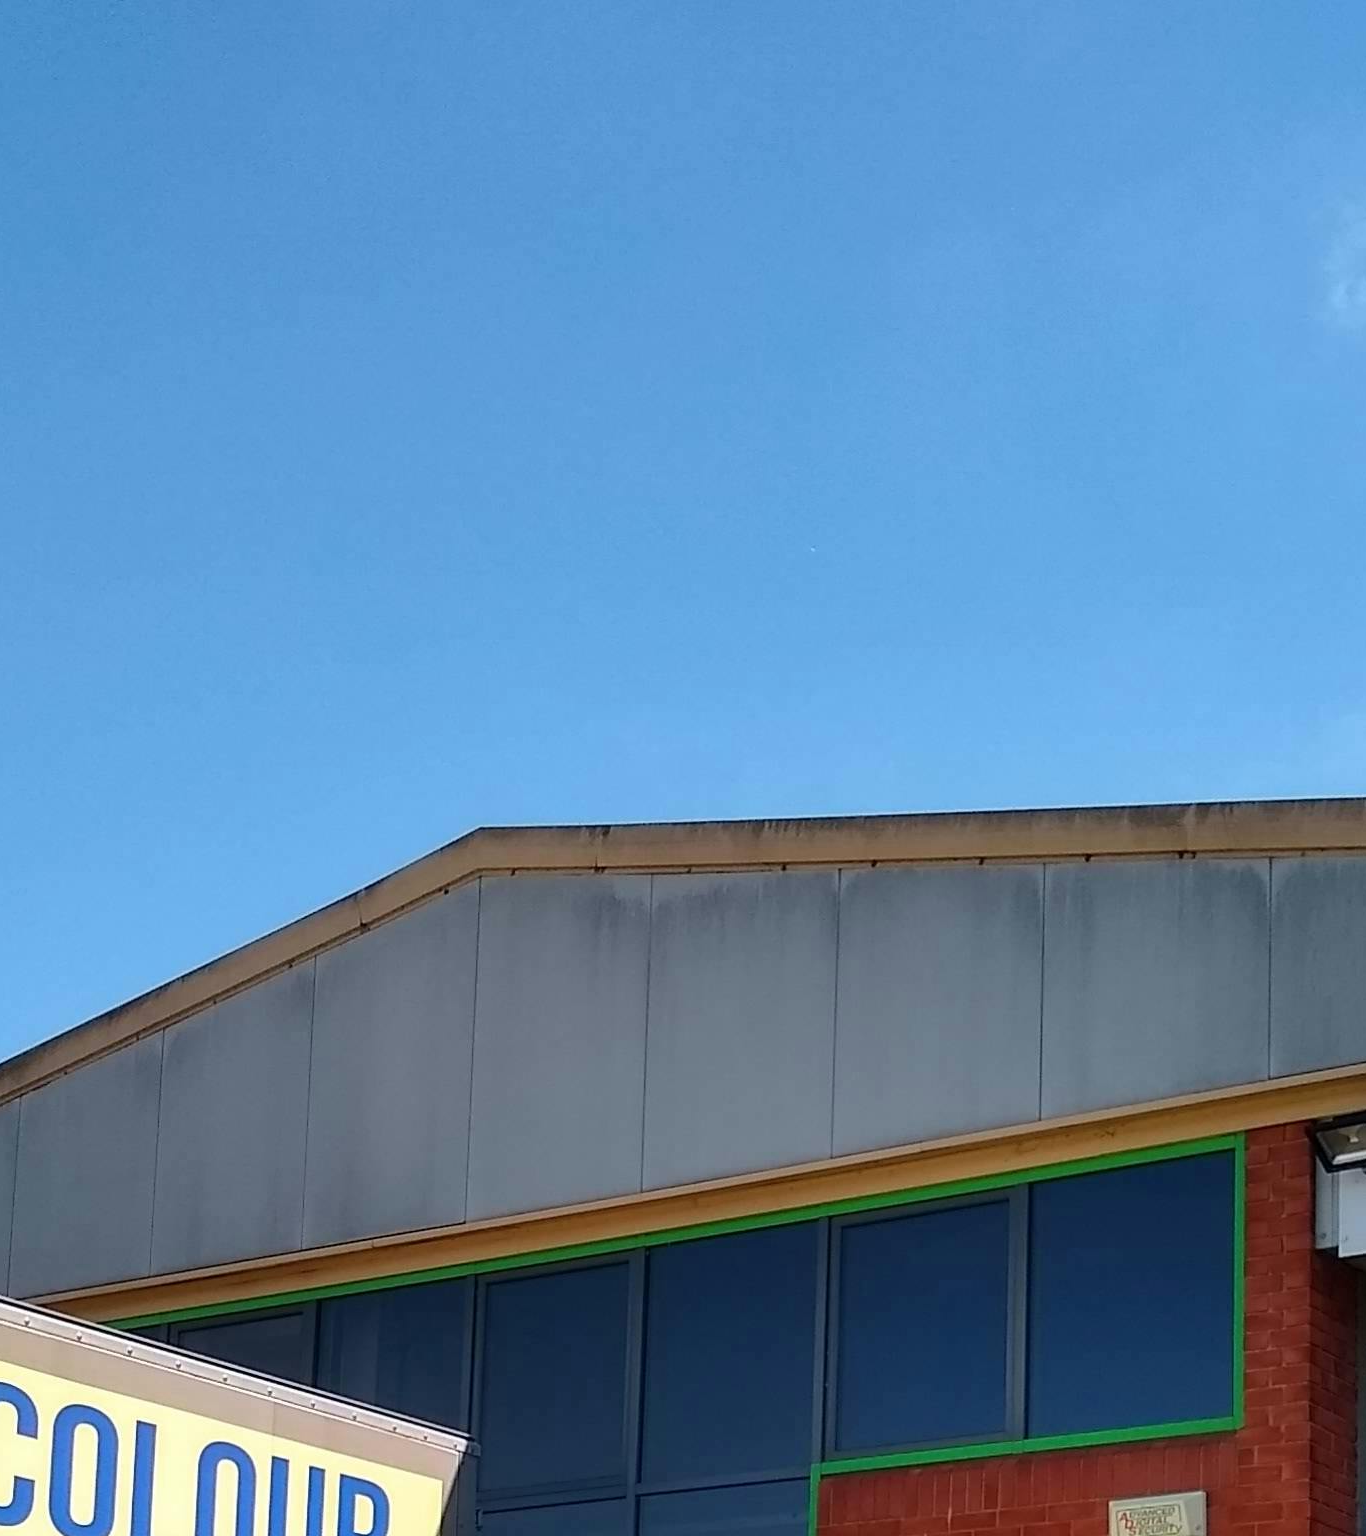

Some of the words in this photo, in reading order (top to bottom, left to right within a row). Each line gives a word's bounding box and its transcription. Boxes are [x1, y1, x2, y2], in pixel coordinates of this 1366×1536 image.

[1119, 1506, 1176, 1521] ADVANCED
[1124, 1516, 1168, 1530] DIGITAL
[1128, 1523, 1183, 1536] SECURITY
